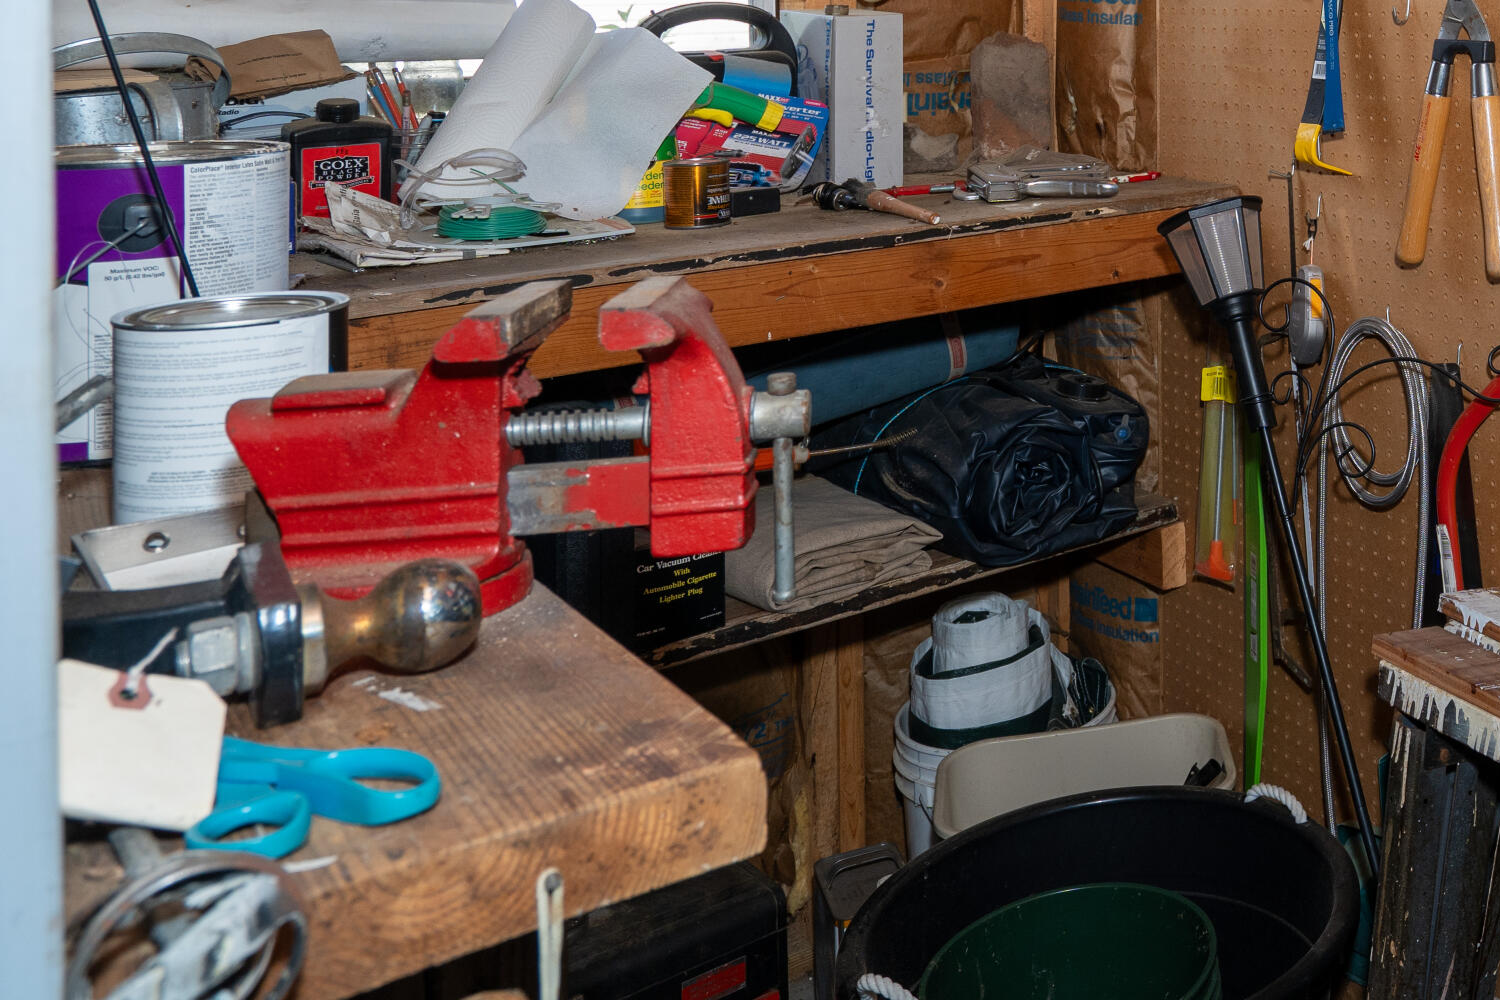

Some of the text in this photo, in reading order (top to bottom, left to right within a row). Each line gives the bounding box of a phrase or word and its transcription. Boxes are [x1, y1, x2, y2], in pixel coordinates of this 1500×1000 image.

[865, 19, 875, 109] The Survival
[733, 132, 790, 148] 225 WATT
[320, 158, 362, 171] GOEX
[323, 168, 361, 176] BLACK
[318, 172, 367, 181] POWDER
[636, 554, 691, 574] Car Vacuum
[673, 568, 691, 577] With
[643, 570, 718, 595] Automobile Cigarette
[659, 587, 704, 604] Lighter Plug
